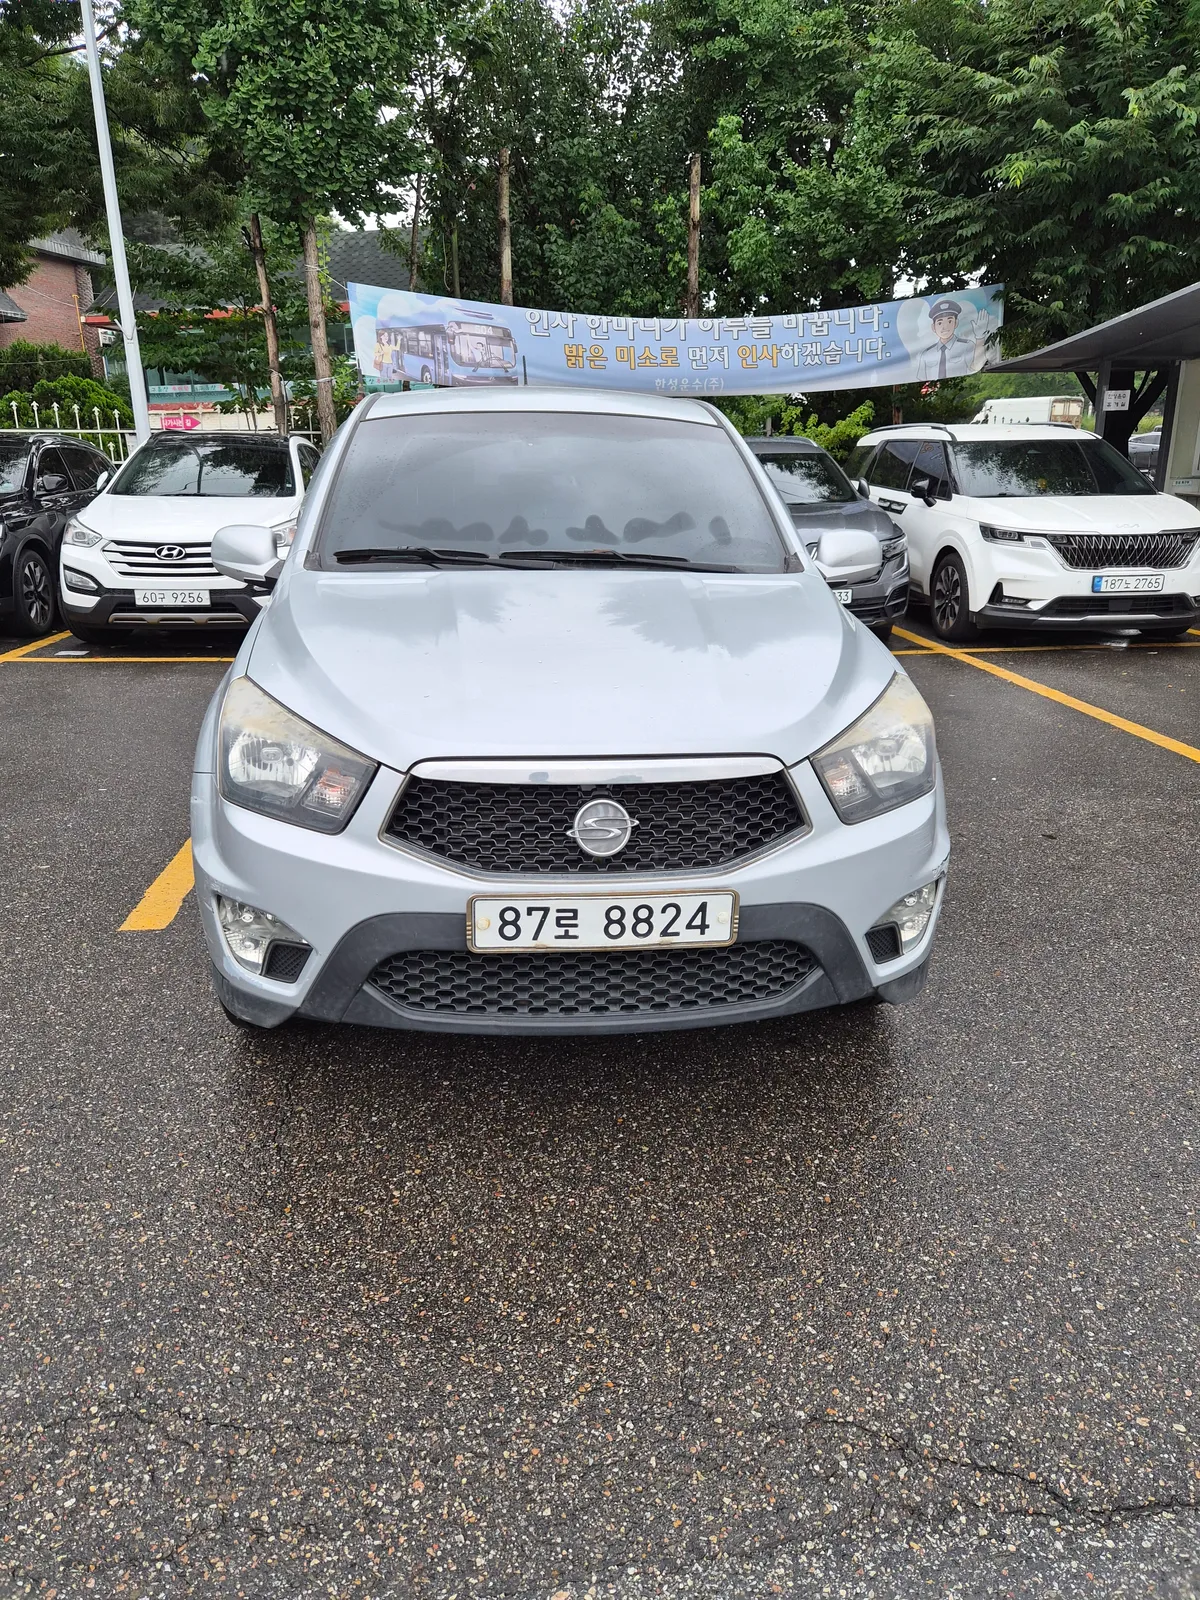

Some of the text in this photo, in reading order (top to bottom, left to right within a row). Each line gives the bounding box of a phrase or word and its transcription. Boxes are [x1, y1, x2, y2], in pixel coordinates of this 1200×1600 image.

[525, 309, 577, 339] 인사
[564, 336, 892, 370] 밝은 미소로 먼저 인사하겠습니다.
[655, 377, 725, 393] 한성운수(주)
[1104, 577, 1161, 590] 187노 2765
[142, 592, 204, 603] 60구 9256
[833, 591, 849, 602] 33
[498, 901, 710, 941] 87로 8824
